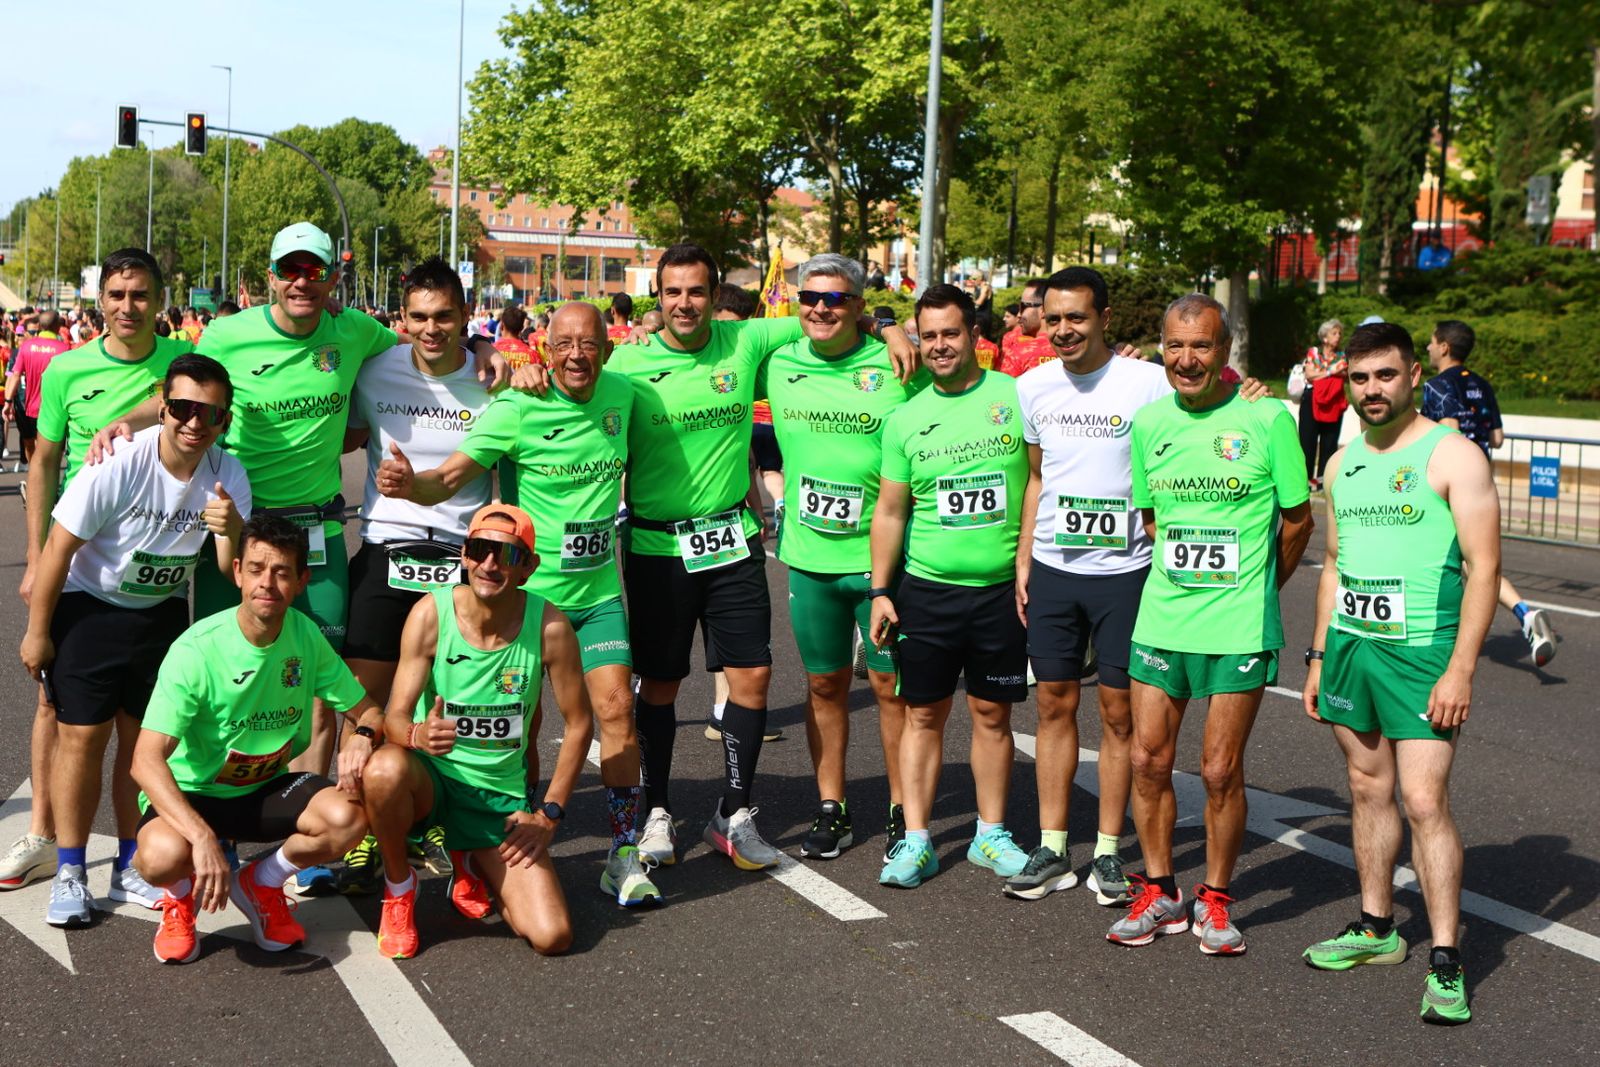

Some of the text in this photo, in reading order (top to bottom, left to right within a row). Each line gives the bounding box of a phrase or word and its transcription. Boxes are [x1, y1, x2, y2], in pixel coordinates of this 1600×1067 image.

[247, 392, 340, 413] SANMAXIMO
[376, 401, 472, 421] SANMAXIMO
[279, 405, 335, 421] TELECOM
[651, 402, 742, 425] SANMAXIMO
[783, 407, 871, 424] SANMAXIMO
[1036, 414, 1122, 427] SANMAXIMO
[683, 416, 738, 432] TELECOM
[808, 422, 864, 434] TELECOM
[1061, 426, 1114, 438] TELECOM
[541, 458, 622, 476] SANMAXIMO
[571, 470, 621, 485] TELECOM
[938, 479, 954, 490] XIV
[1149, 477, 1240, 491] SANMAXIMO
[807, 492, 850, 519] 973
[948, 488, 996, 514] 978
[1172, 491, 1233, 502] TELECOM
[1338, 504, 1413, 519] SANMAXIMO
[565, 522, 582, 533] XIV
[1066, 511, 1115, 535] 970
[1360, 516, 1407, 527] TELECOM
[689, 527, 736, 556] 954
[1167, 528, 1182, 540] XIV
[572, 531, 609, 557] 968
[1174, 543, 1225, 570] 975
[136, 565, 185, 585] 960
[400, 565, 449, 583] 956
[1343, 591, 1391, 621] 976
[456, 717, 510, 738] 959
[232, 756, 281, 778] 514
